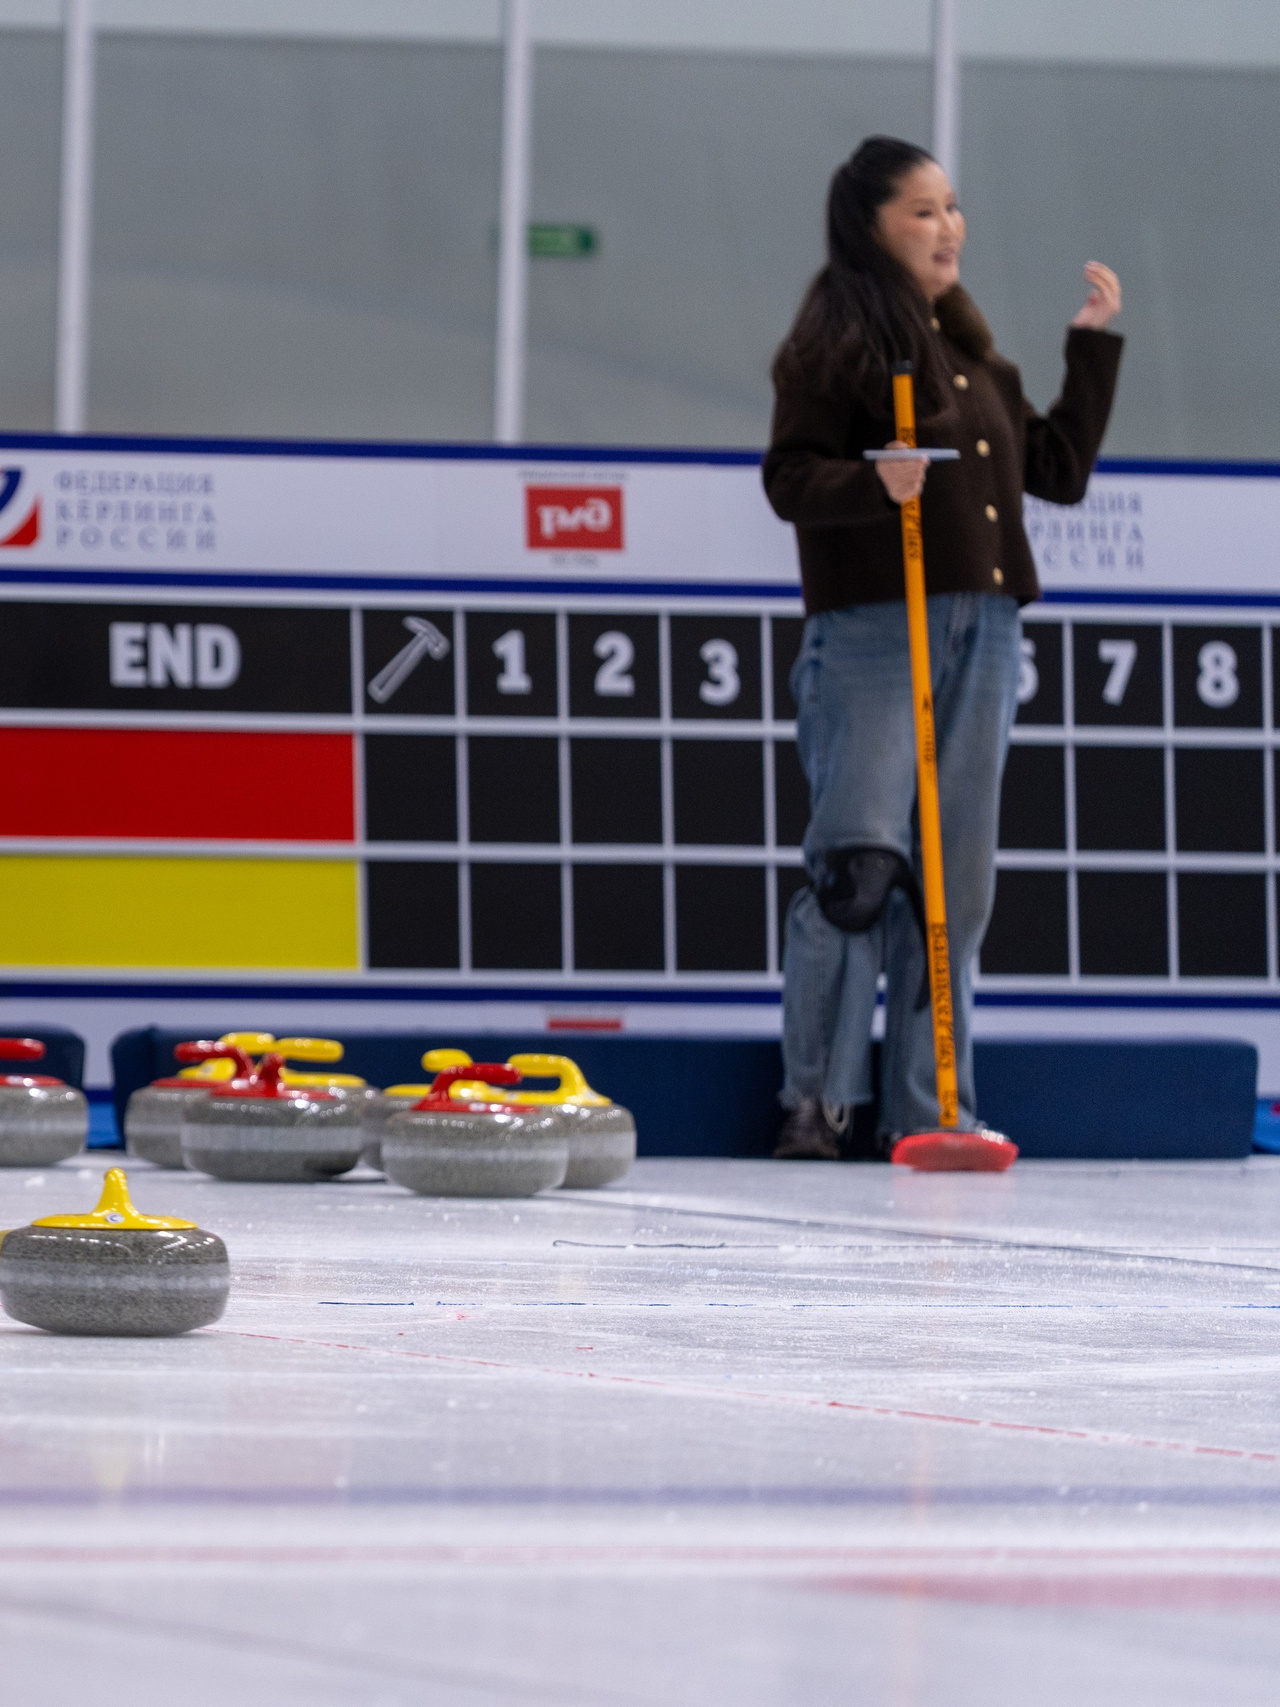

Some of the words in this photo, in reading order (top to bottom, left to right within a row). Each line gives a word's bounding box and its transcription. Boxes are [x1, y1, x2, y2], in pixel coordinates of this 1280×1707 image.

[55, 470, 215, 495] ФЕДЕРАЦИЯ
[56, 500, 216, 524] КЕРЛИНГА
[56, 526, 216, 551] РОССИИ
[1029, 518, 1144, 543] РЛИНГА
[1042, 545, 1144, 571] ССИИ
[109, 622, 241, 689] END
[493, 630, 532, 694] 1
[594, 631, 635, 696] 2
[700, 639, 740, 705] 3
[1098, 640, 1138, 704] 7
[1196, 641, 1239, 708] 8
